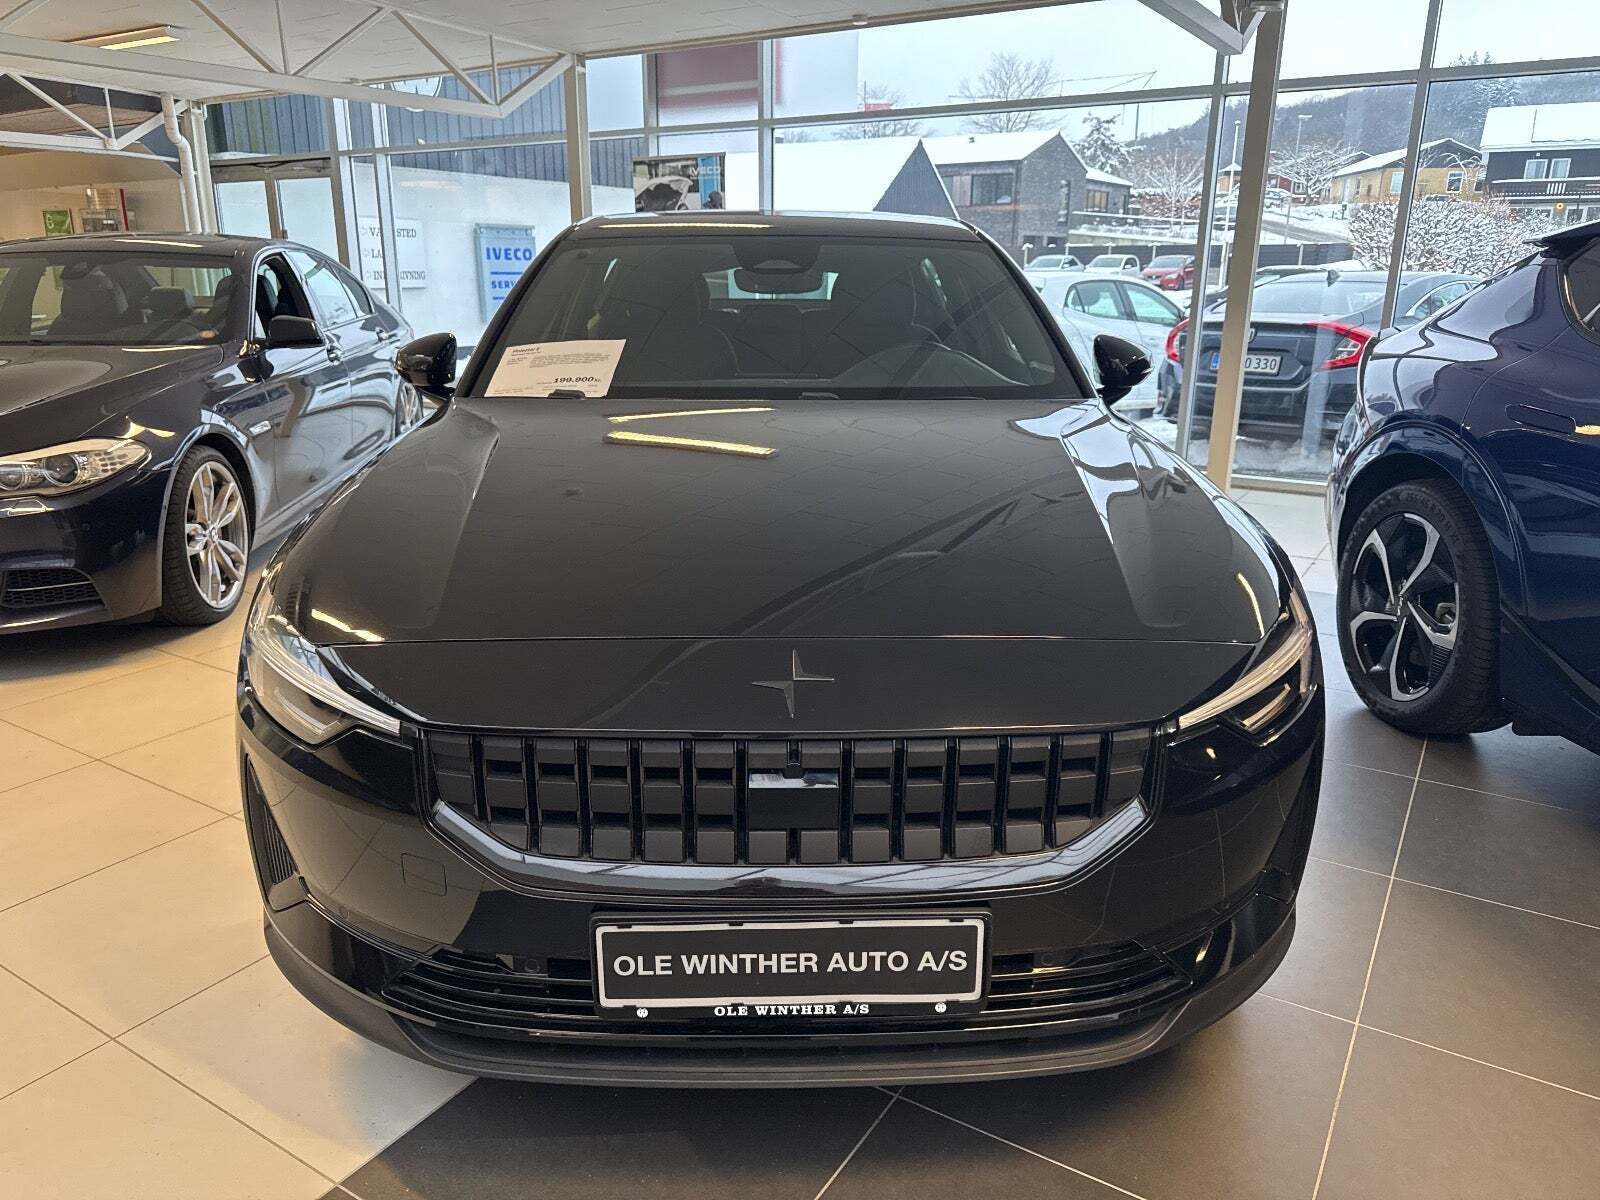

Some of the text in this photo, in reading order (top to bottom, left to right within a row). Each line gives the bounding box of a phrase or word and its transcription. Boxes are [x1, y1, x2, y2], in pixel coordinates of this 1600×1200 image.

[486, 247, 532, 260] IVECO
[1253, 357, 1277, 369] 330
[554, 376, 594, 384] 199.900
[613, 950, 968, 976] OLE WINTHER AUTO A/S
[714, 1004, 870, 1016] OLE WINTHER A/S
